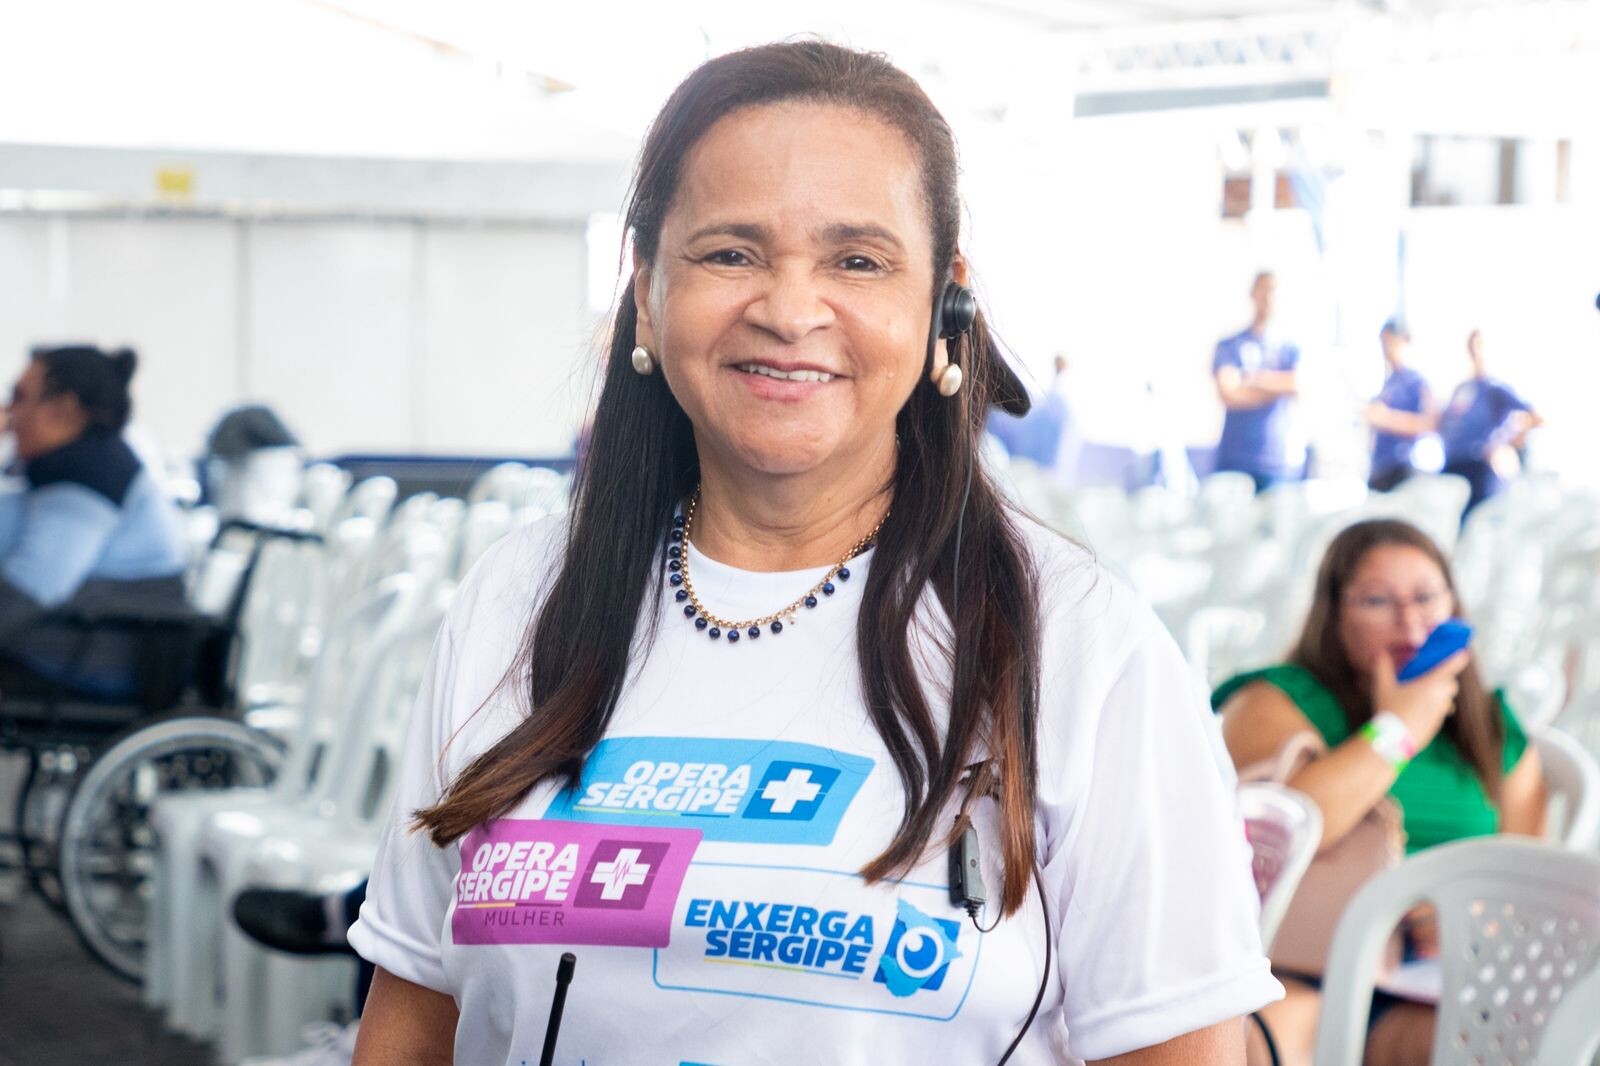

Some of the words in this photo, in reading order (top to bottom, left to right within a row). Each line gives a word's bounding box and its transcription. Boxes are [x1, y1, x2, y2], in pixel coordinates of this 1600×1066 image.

[623, 760, 752, 789] OPERA
[577, 781, 749, 814] SERGIPE
[472, 840, 580, 872] OPERA
[457, 869, 570, 903] SERGIPE
[484, 909, 566, 927] MULHER
[684, 899, 874, 945] ENXERGA
[704, 929, 872, 974] SERGIPE
